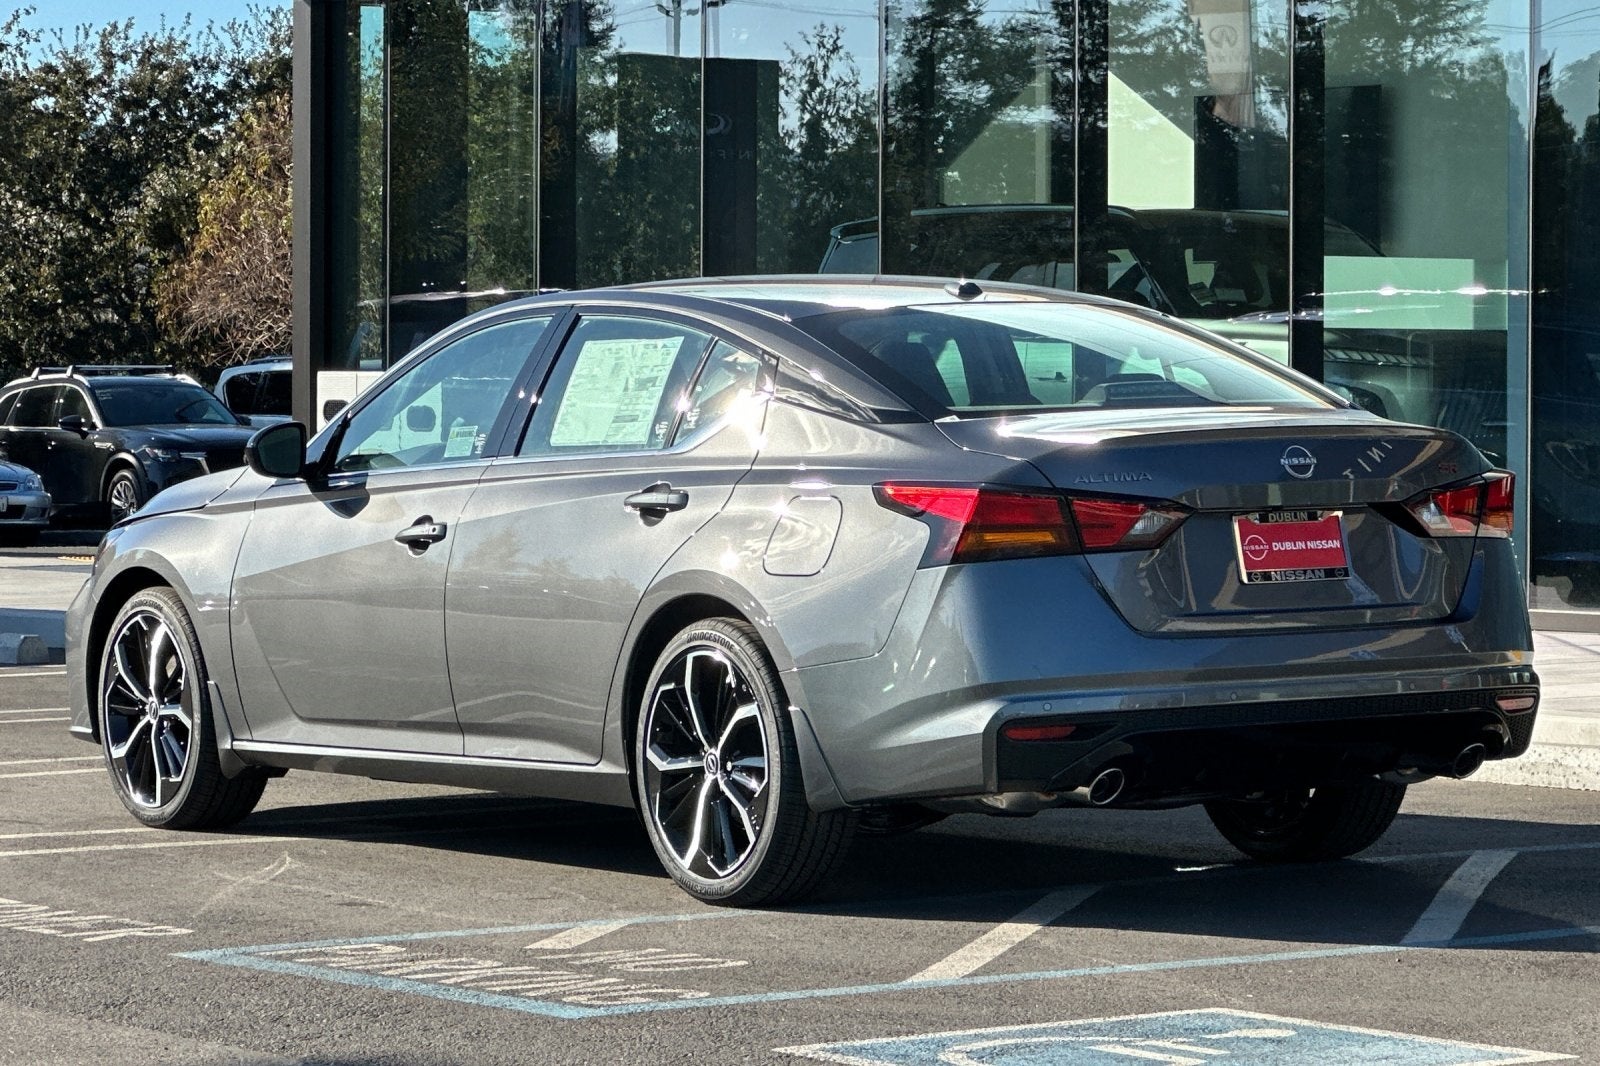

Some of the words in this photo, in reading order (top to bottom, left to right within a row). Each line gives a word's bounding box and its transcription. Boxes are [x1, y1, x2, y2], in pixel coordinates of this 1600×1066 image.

[1280, 457, 1317, 466] NISSAN
[1074, 471, 1153, 484] ALTIMA
[1268, 511, 1308, 522] DUBLIN
[1243, 543, 1269, 551] NISSAN
[1272, 541, 1306, 551] DUBLIN
[1307, 540, 1341, 550] NISSAN
[1271, 569, 1325, 581] NISSAN
[687, 632, 735, 651] BRIDGESTONE
[256, 943, 711, 1005] PARKING
